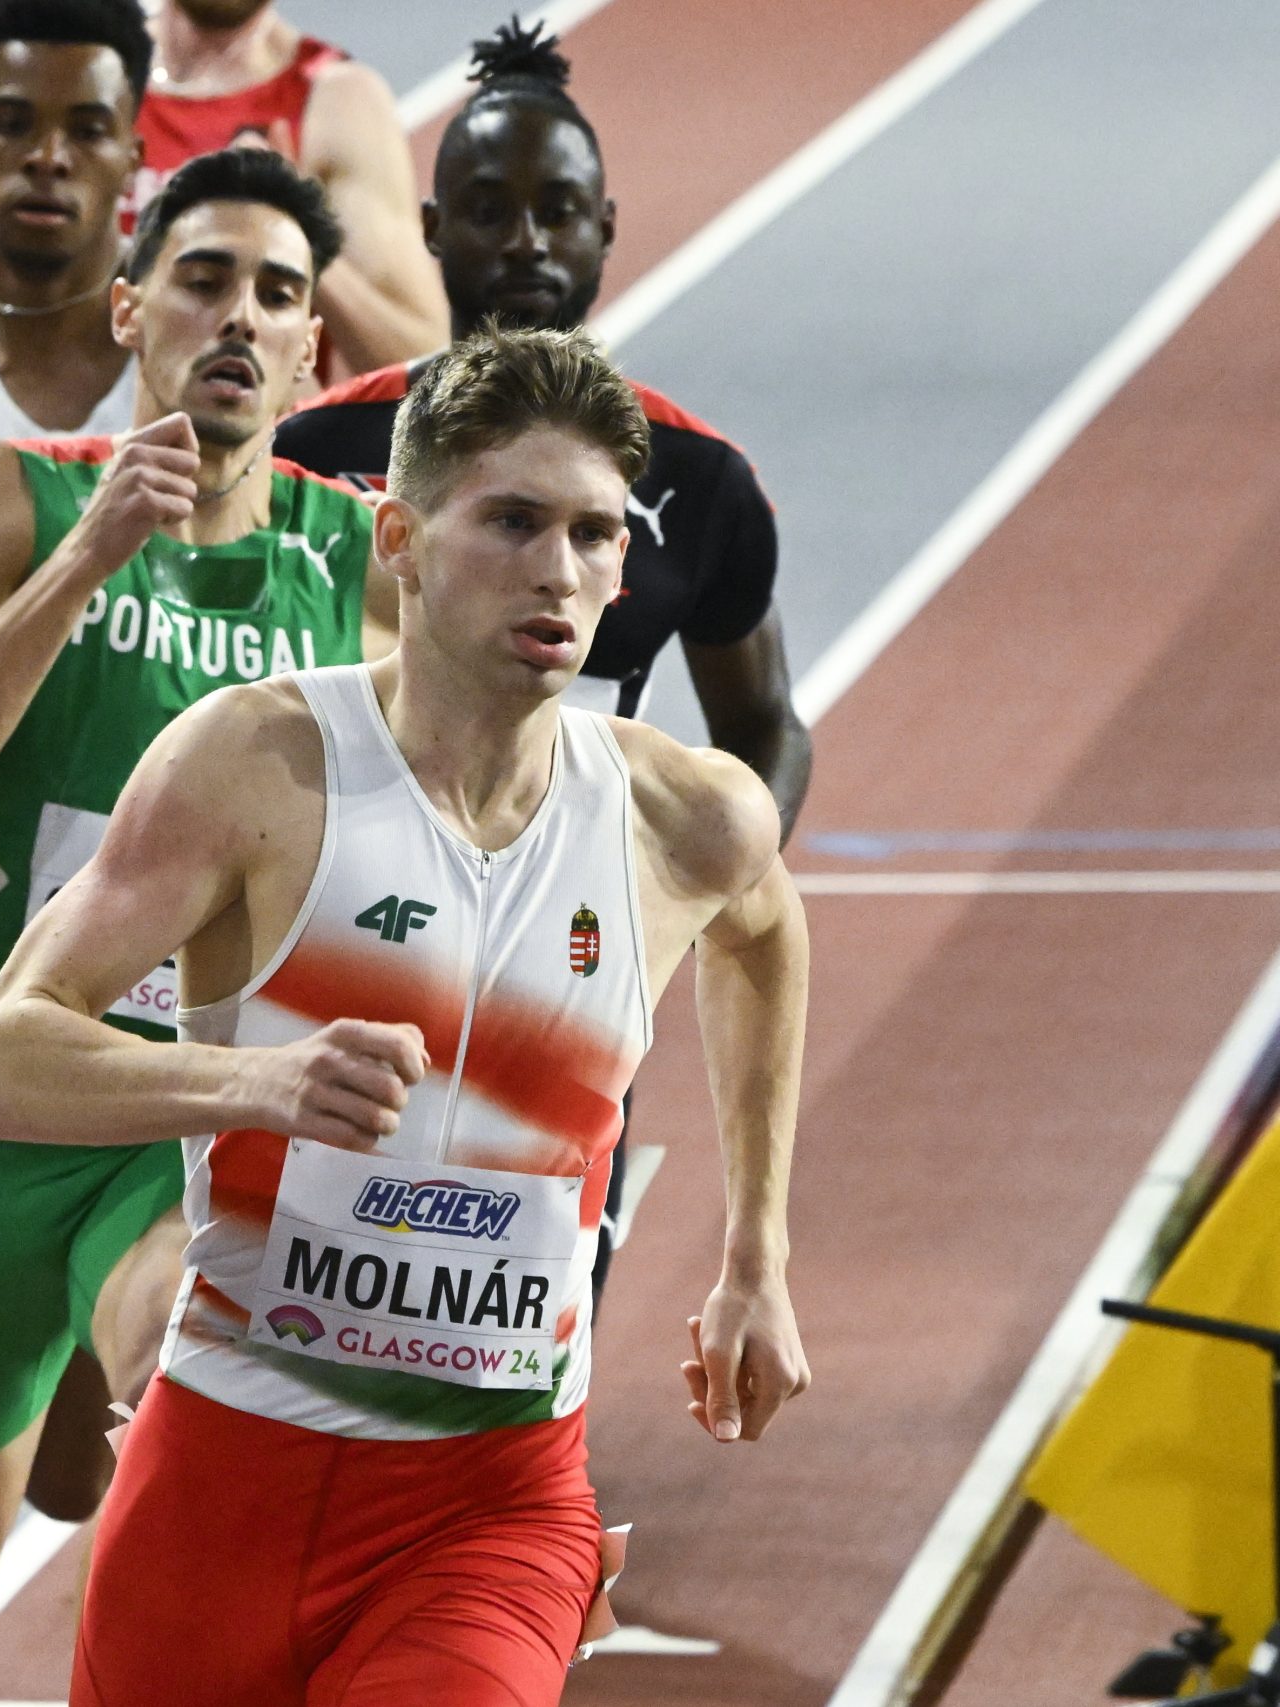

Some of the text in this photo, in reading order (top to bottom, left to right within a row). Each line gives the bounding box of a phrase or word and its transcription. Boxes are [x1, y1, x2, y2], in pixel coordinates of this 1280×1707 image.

[354, 894, 438, 944] 4F
[352, 1175, 521, 1241] HI-CHEW
[283, 1236, 550, 1329] MOLNÁR
[336, 1326, 540, 1376] GLASGOW 24
